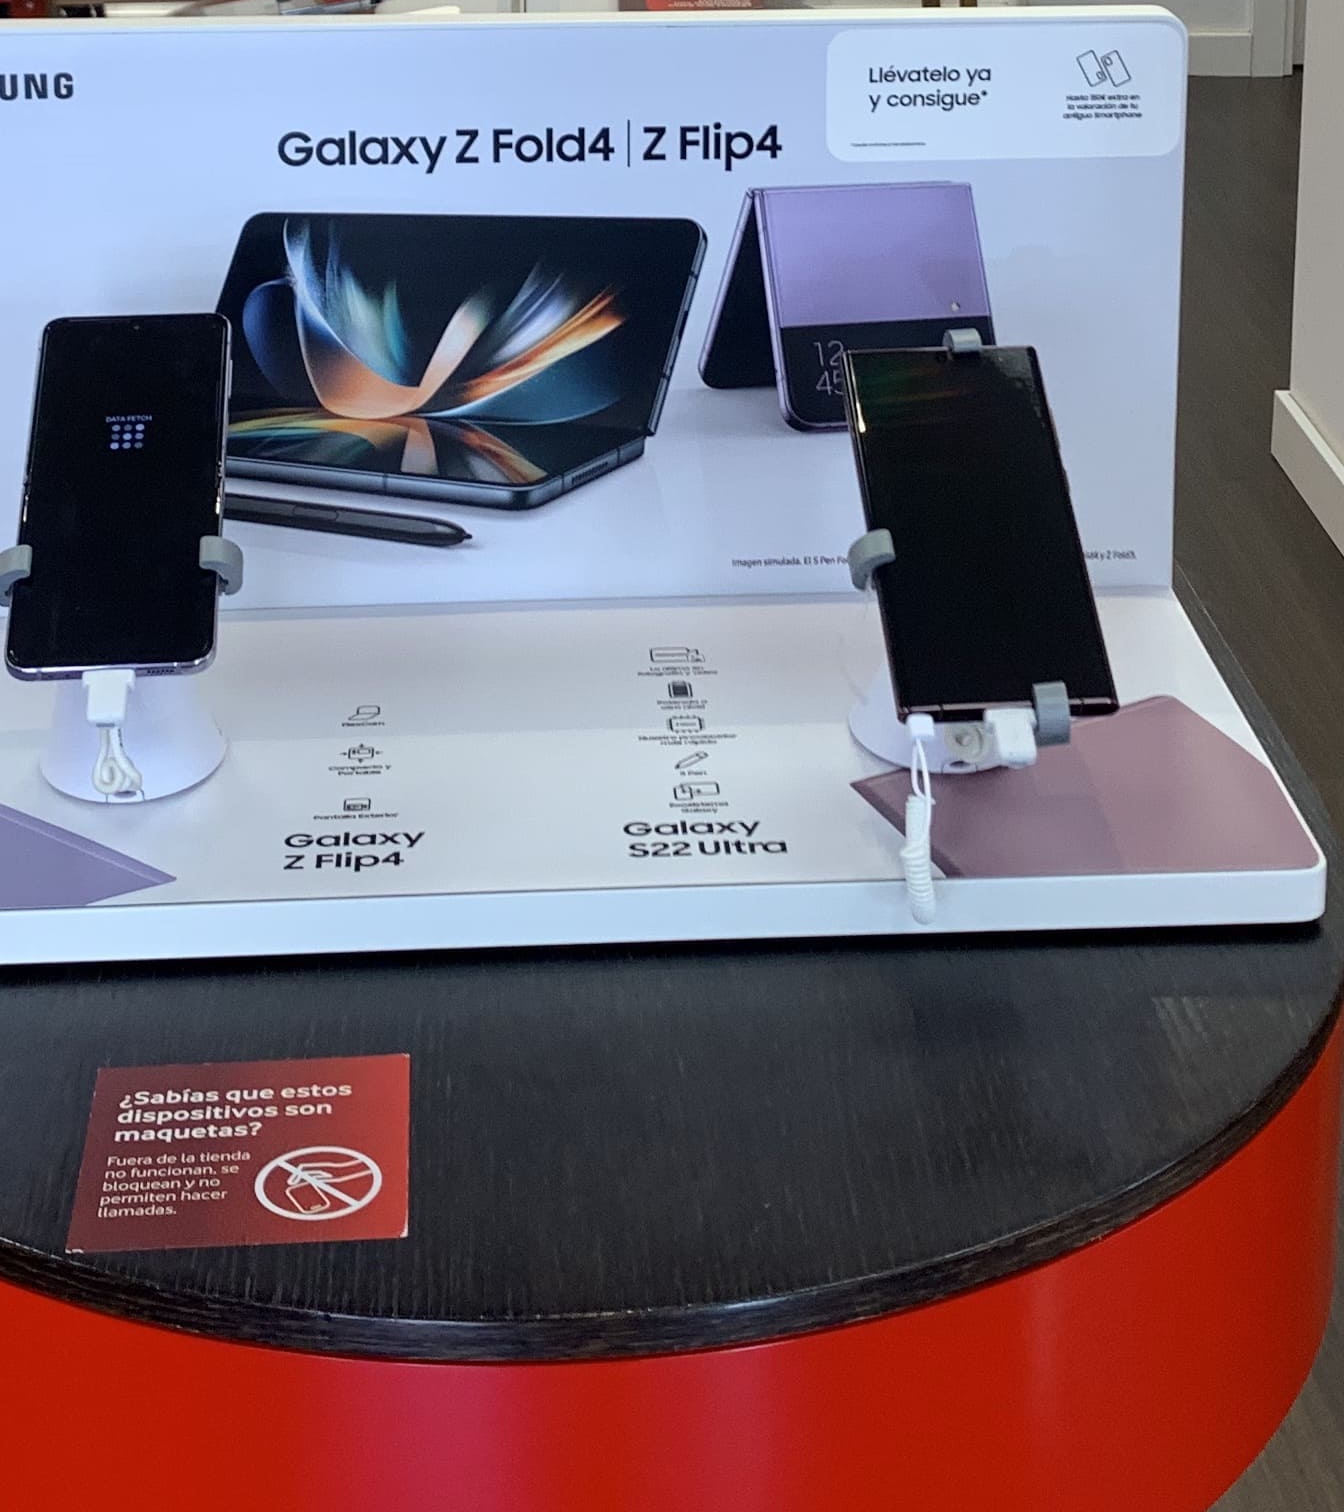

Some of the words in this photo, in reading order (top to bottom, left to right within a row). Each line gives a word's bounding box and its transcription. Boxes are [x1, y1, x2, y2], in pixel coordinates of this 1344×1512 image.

[869, 64, 961, 84] Llévatelo
[966, 67, 992, 87] ya
[869, 92, 881, 114] y
[277, 130, 447, 175] Galaxy
[455, 129, 480, 163] Z
[493, 126, 615, 164] Fold4
[642, 126, 667, 161] Z
[679, 122, 783, 172] Flip4
[813, 340, 844, 367] 12
[127, 414, 153, 422] FETCH
[732, 558, 762, 568] Imagen
[837, 556, 849, 565] Fo
[623, 820, 760, 839] Galaxy
[283, 831, 425, 850] Galaxy
[629, 840, 693, 858] S22
[698, 836, 788, 856] Ultra
[283, 854, 305, 870] Z
[315, 850, 406, 872] Flip4
[119, 1088, 219, 1109] ¿Sabías
[226, 1088, 274, 1103] que
[280, 1083, 353, 1100] estos
[117, 1105, 278, 1125] dispositivos
[285, 1101, 333, 1117] son
[114, 1121, 262, 1143] maquetas?
[107, 1155, 153, 1167] Fuera
[156, 1153, 177, 1165] de
[181, 1152, 196, 1164] la
[200, 1150, 251, 1163] tienda
[105, 1169, 126, 1179] no
[221, 1164, 239, 1174] se
[102, 1178, 181, 1193] bloquean
[184, 1179, 196, 1190] y
[199, 1177, 221, 1188] no
[99, 1192, 177, 1207] permiten
[180, 1190, 228, 1202] hacer
[97, 1205, 177, 1219] llamadas.
